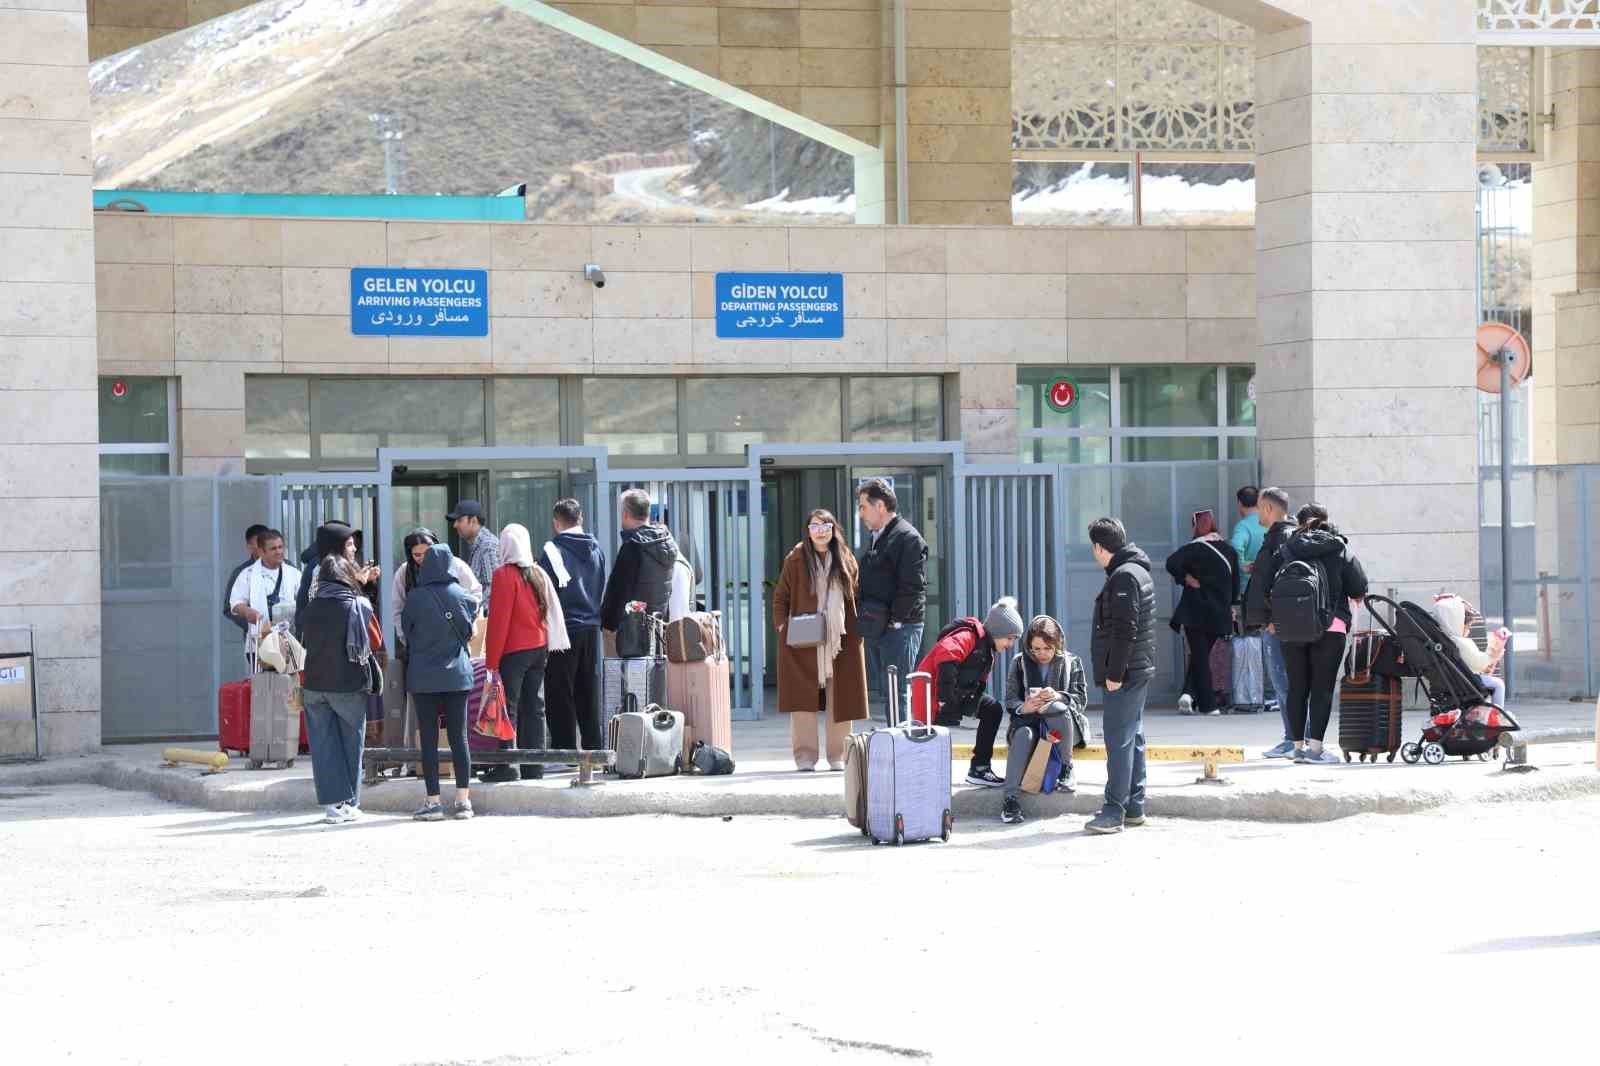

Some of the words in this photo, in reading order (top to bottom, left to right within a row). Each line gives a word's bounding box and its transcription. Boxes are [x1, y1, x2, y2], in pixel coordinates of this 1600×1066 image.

[363, 277, 417, 293] GELEN
[421, 278, 476, 294] YOLCU
[731, 282, 777, 299] GİDEN
[780, 285, 828, 300] YOLCU
[357, 295, 411, 306] ARRIVING
[414, 296, 482, 308] PASSENGERS
[720, 301, 776, 312] DEPARTING
[778, 301, 839, 312] PASSENGERS
[370, 310, 423, 327] ورودی
[428, 307, 470, 327] مسافر
[735, 312, 784, 329] خروجی
[788, 310, 824, 328] مسافر
